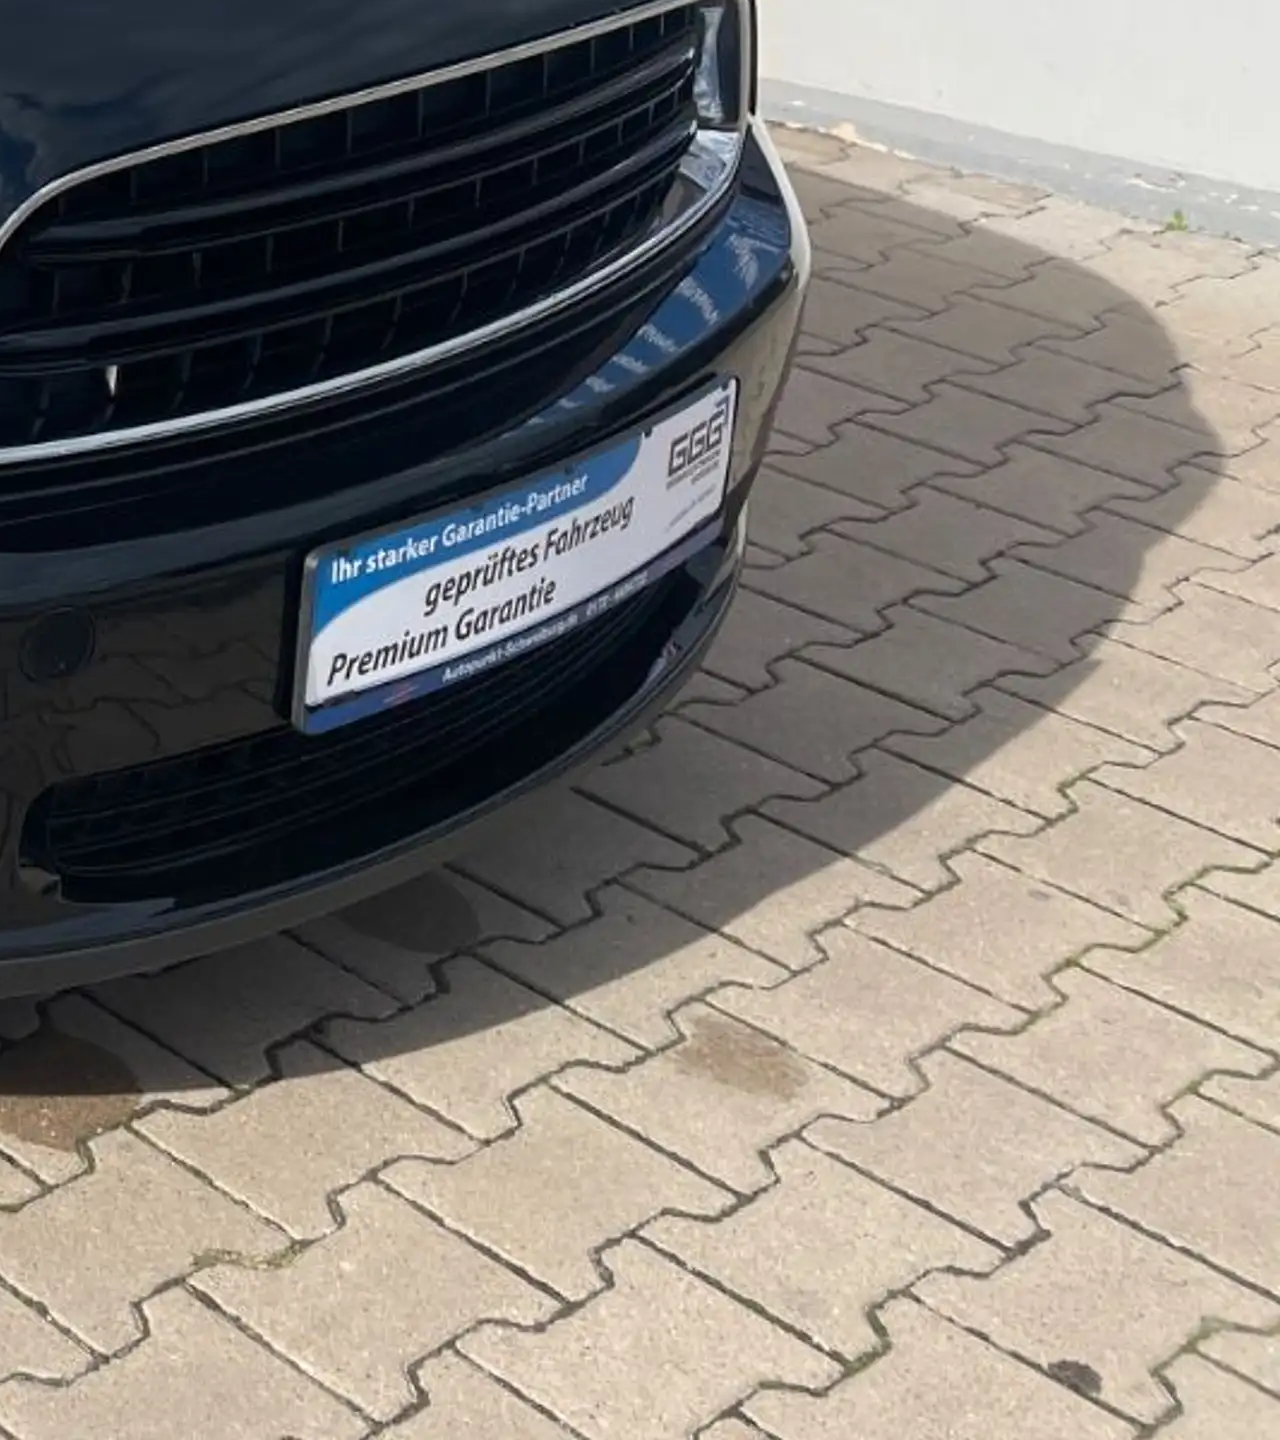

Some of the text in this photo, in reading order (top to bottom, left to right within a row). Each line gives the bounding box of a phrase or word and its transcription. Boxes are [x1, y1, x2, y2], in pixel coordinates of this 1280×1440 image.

[331, 474, 589, 585] Ihr starker Garantie-Partner
[423, 541, 540, 617] geprüftes
[543, 496, 635, 562] Fahrzeug
[326, 576, 557, 687] Premium Garantie
